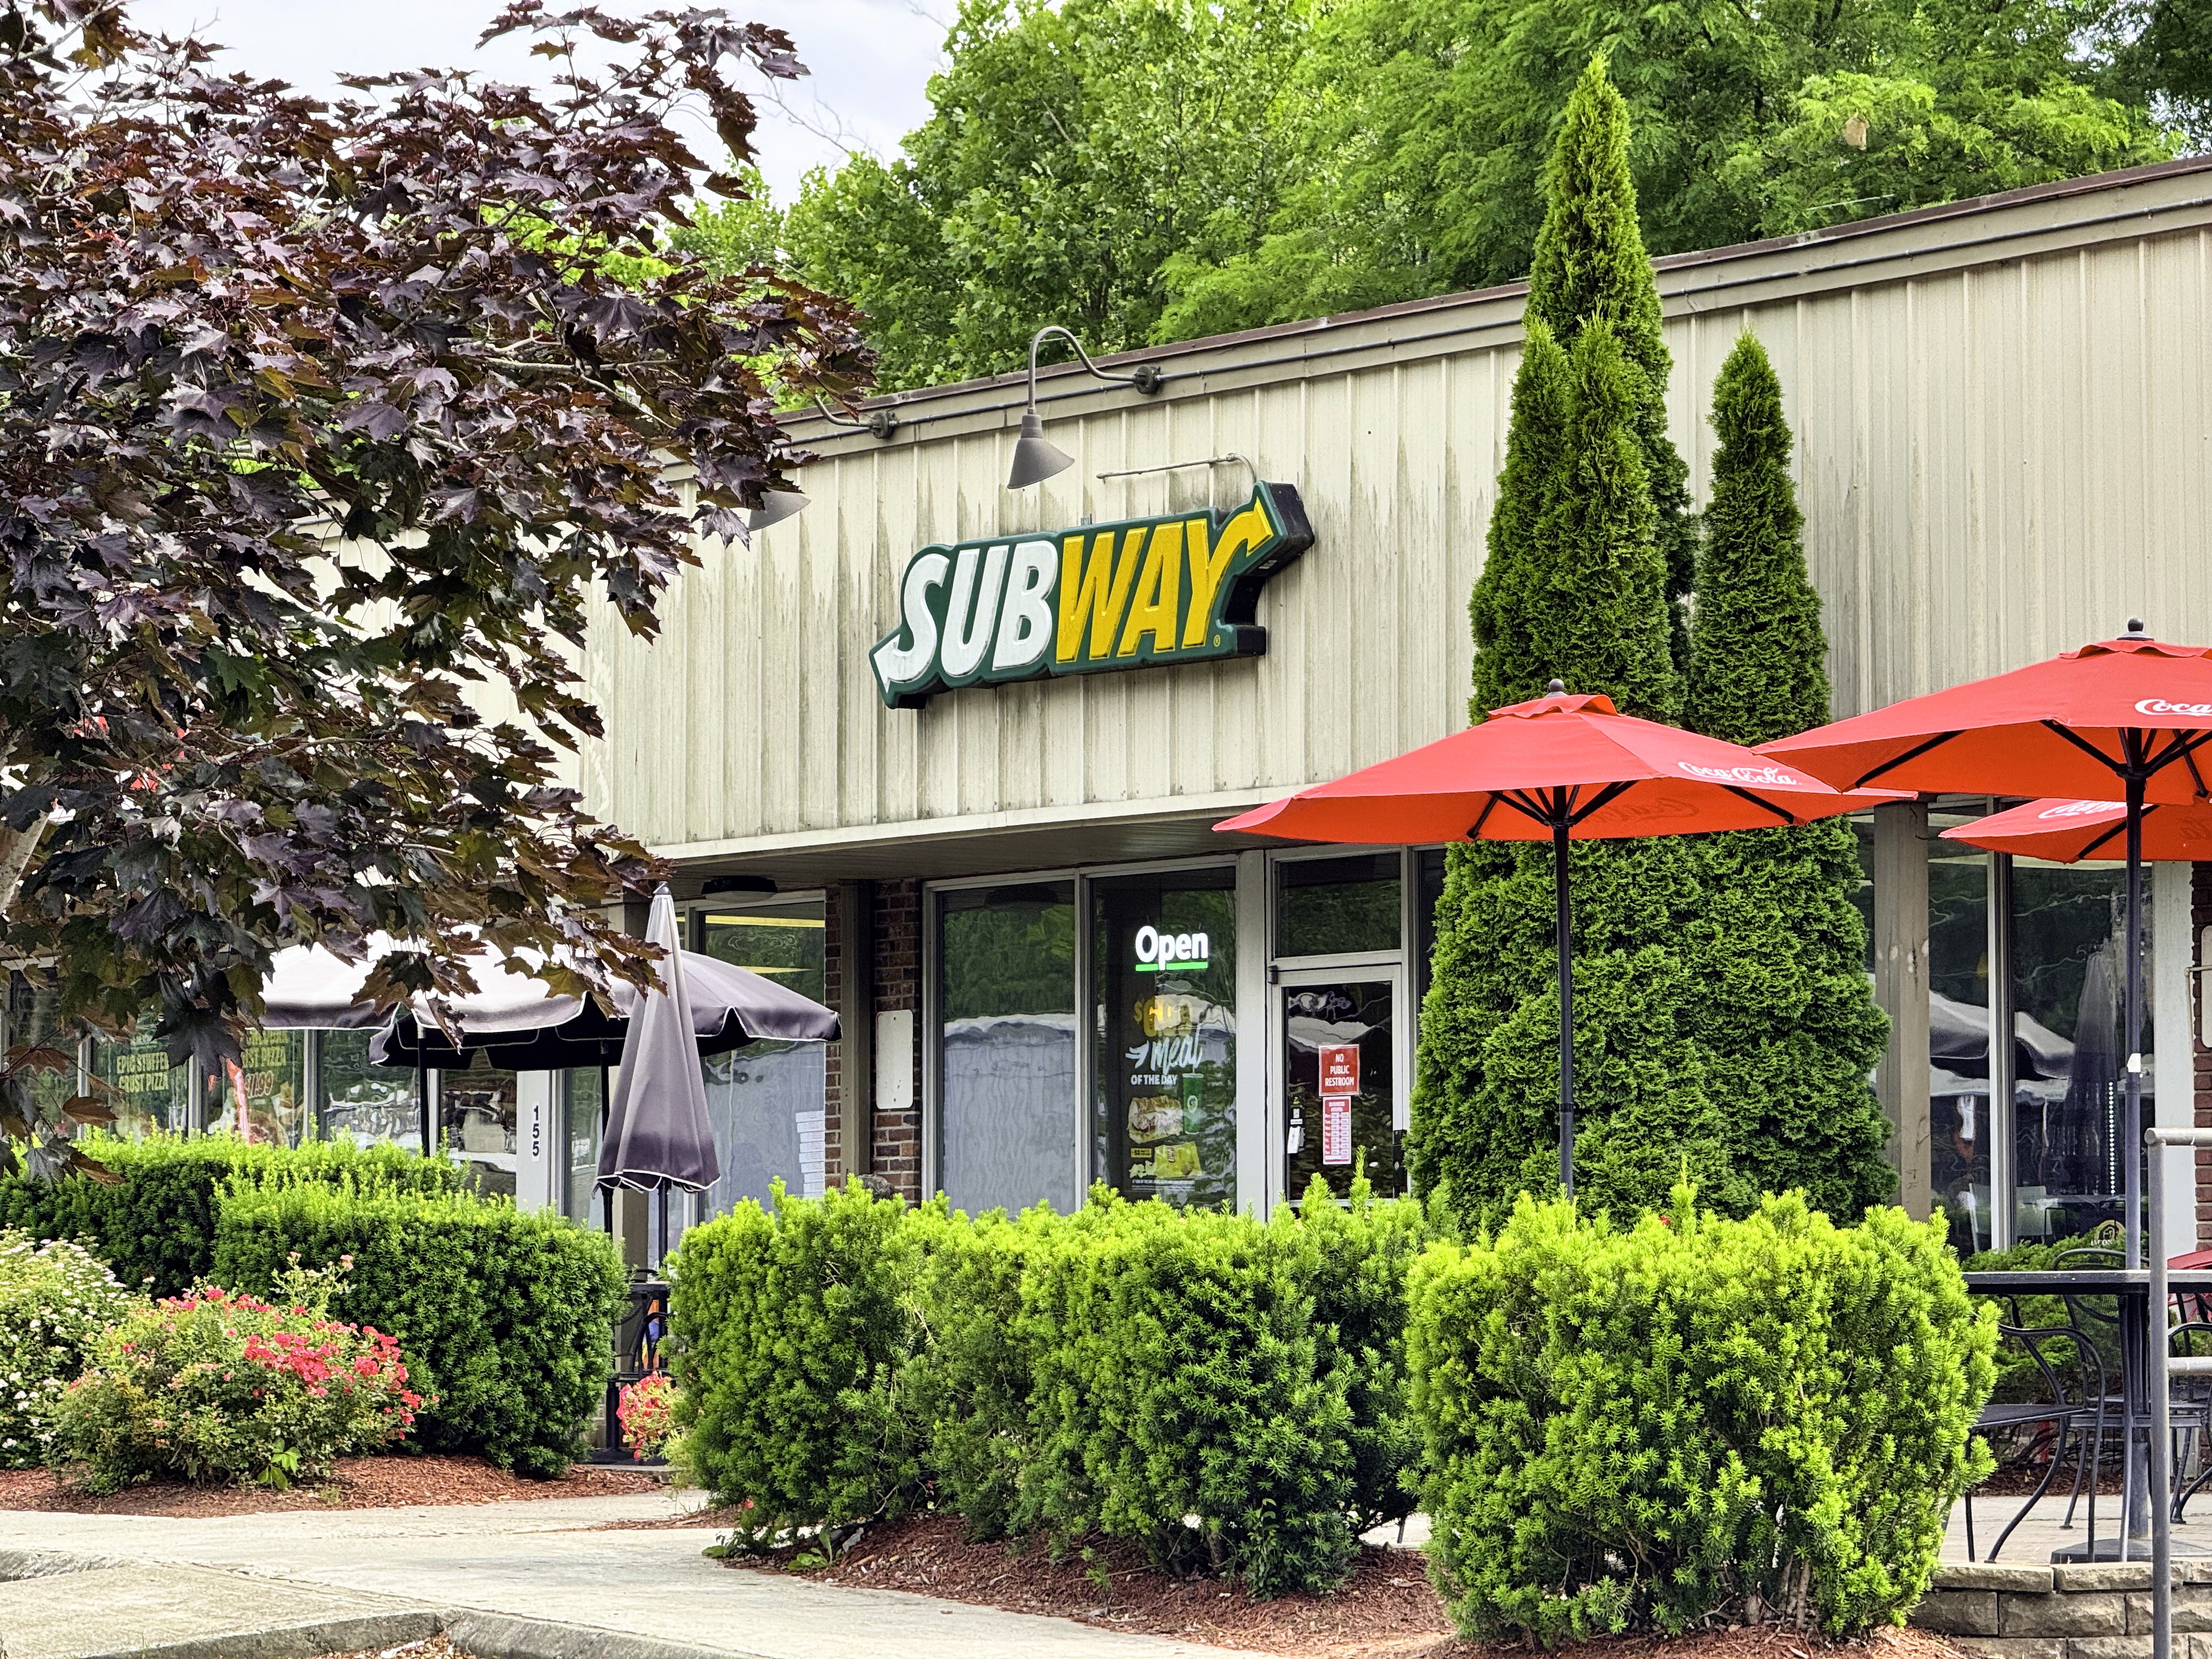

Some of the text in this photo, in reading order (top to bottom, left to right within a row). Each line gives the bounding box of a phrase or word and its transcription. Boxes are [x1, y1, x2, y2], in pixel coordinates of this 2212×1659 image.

[873, 496, 1274, 693] SUBWAY
[1135, 926, 1208, 970] Open
[117, 1055, 136, 1074] EPIC
[1335, 1053, 1344, 1063] NO
[1330, 1065, 1350, 1075] PUBLIC
[119, 1071, 169, 1093] CRUST PIZZA
[1131, 1074, 1178, 1085] OF THE DAY
[1325, 1076, 1355, 1087] RESTROOM
